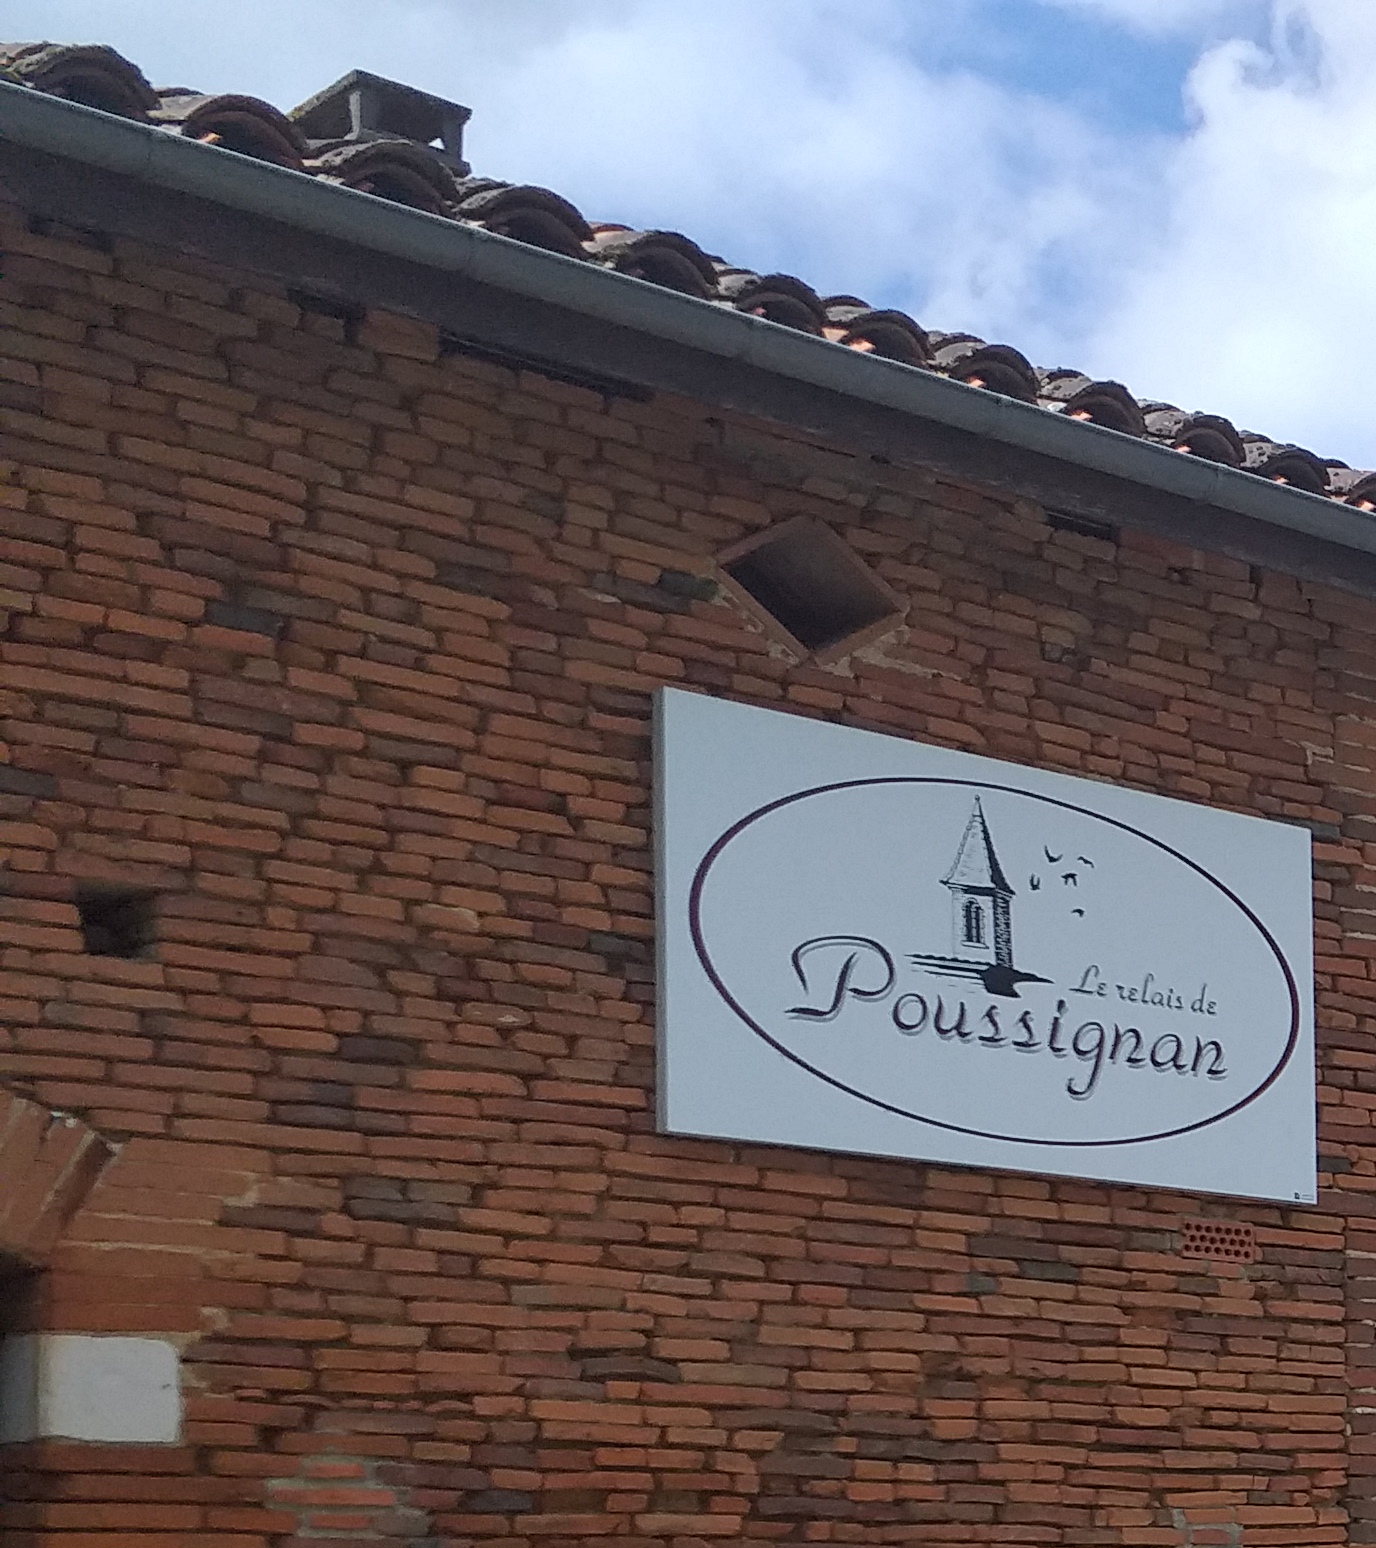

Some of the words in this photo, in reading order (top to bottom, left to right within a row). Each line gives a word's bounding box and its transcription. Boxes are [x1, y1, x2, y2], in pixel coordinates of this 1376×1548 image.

[784, 935, 1228, 1099] Poussignan
[1068, 964, 1108, 997] Le
[1115, 972, 1184, 1010] relais
[1190, 983, 1218, 1015] de
